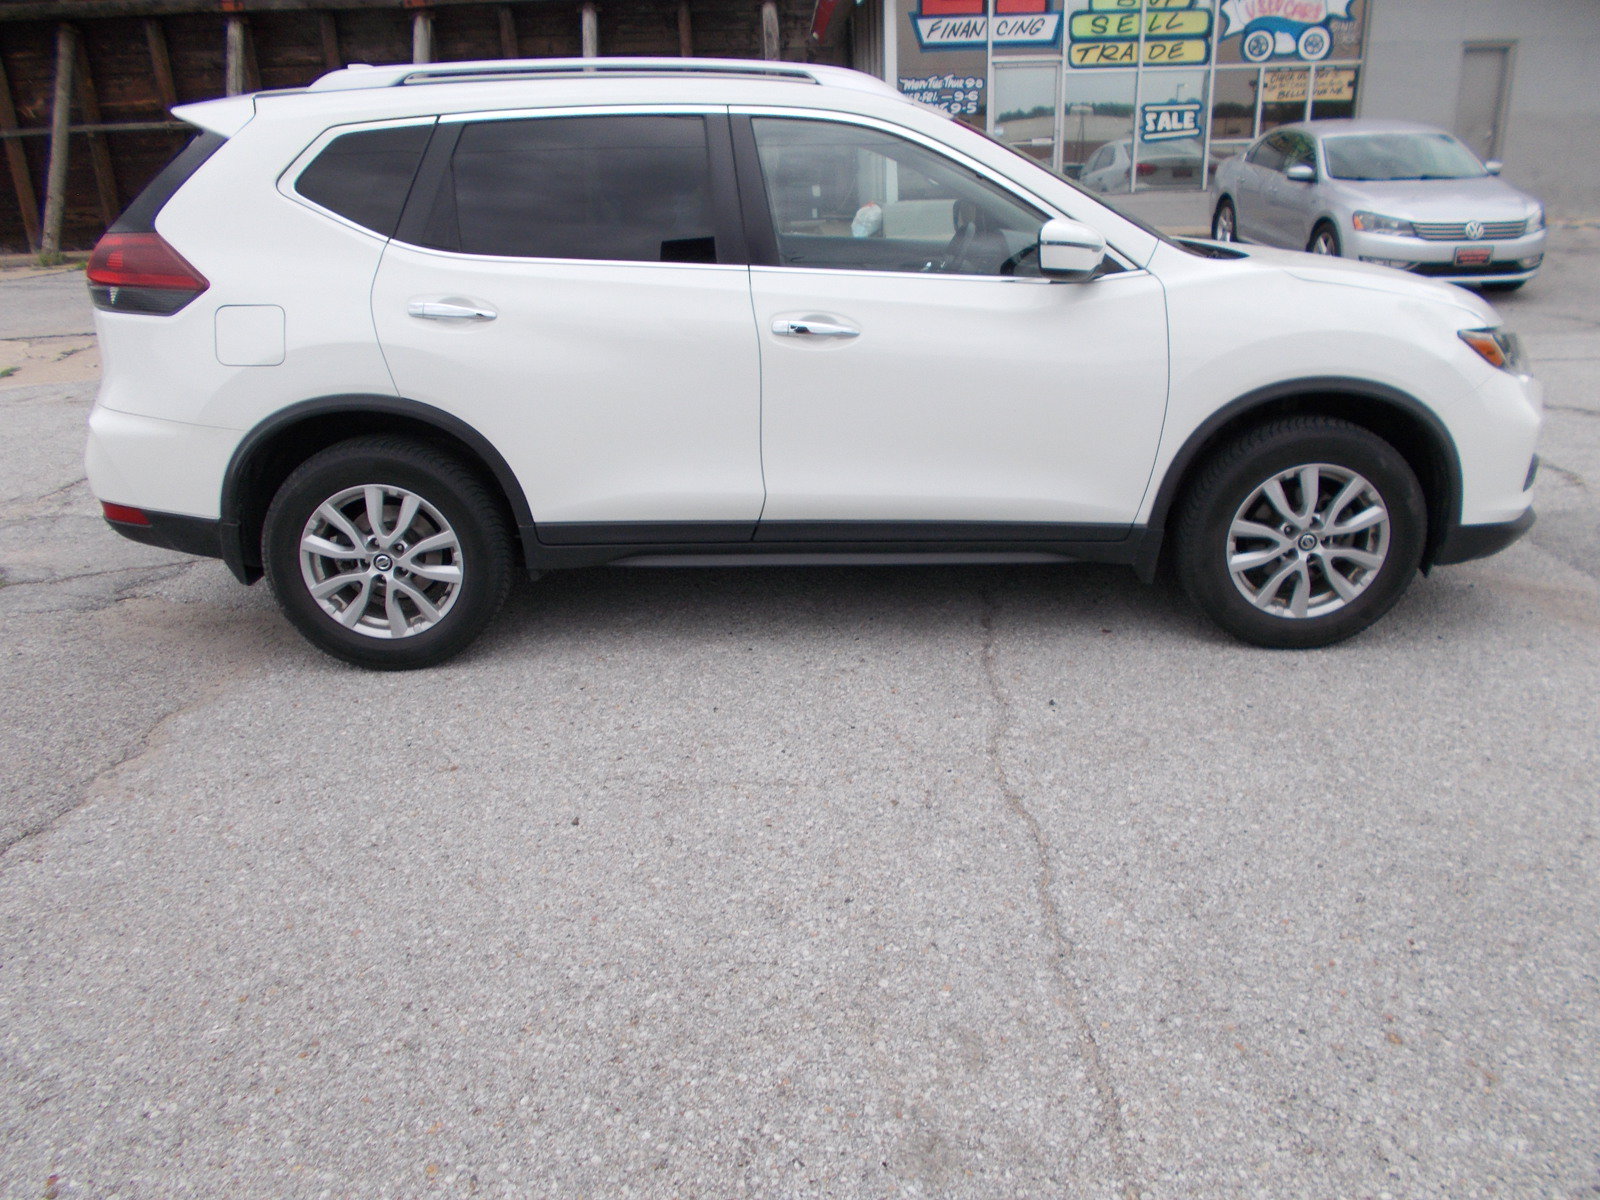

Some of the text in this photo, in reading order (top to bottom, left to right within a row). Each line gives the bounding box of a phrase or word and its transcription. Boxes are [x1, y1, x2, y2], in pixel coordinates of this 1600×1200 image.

[926, 18, 1046, 38] FINANCING
[1091, 13, 1184, 34] SELL
[1077, 41, 1184, 62] TRADE
[1144, 111, 1196, 132] SALE
